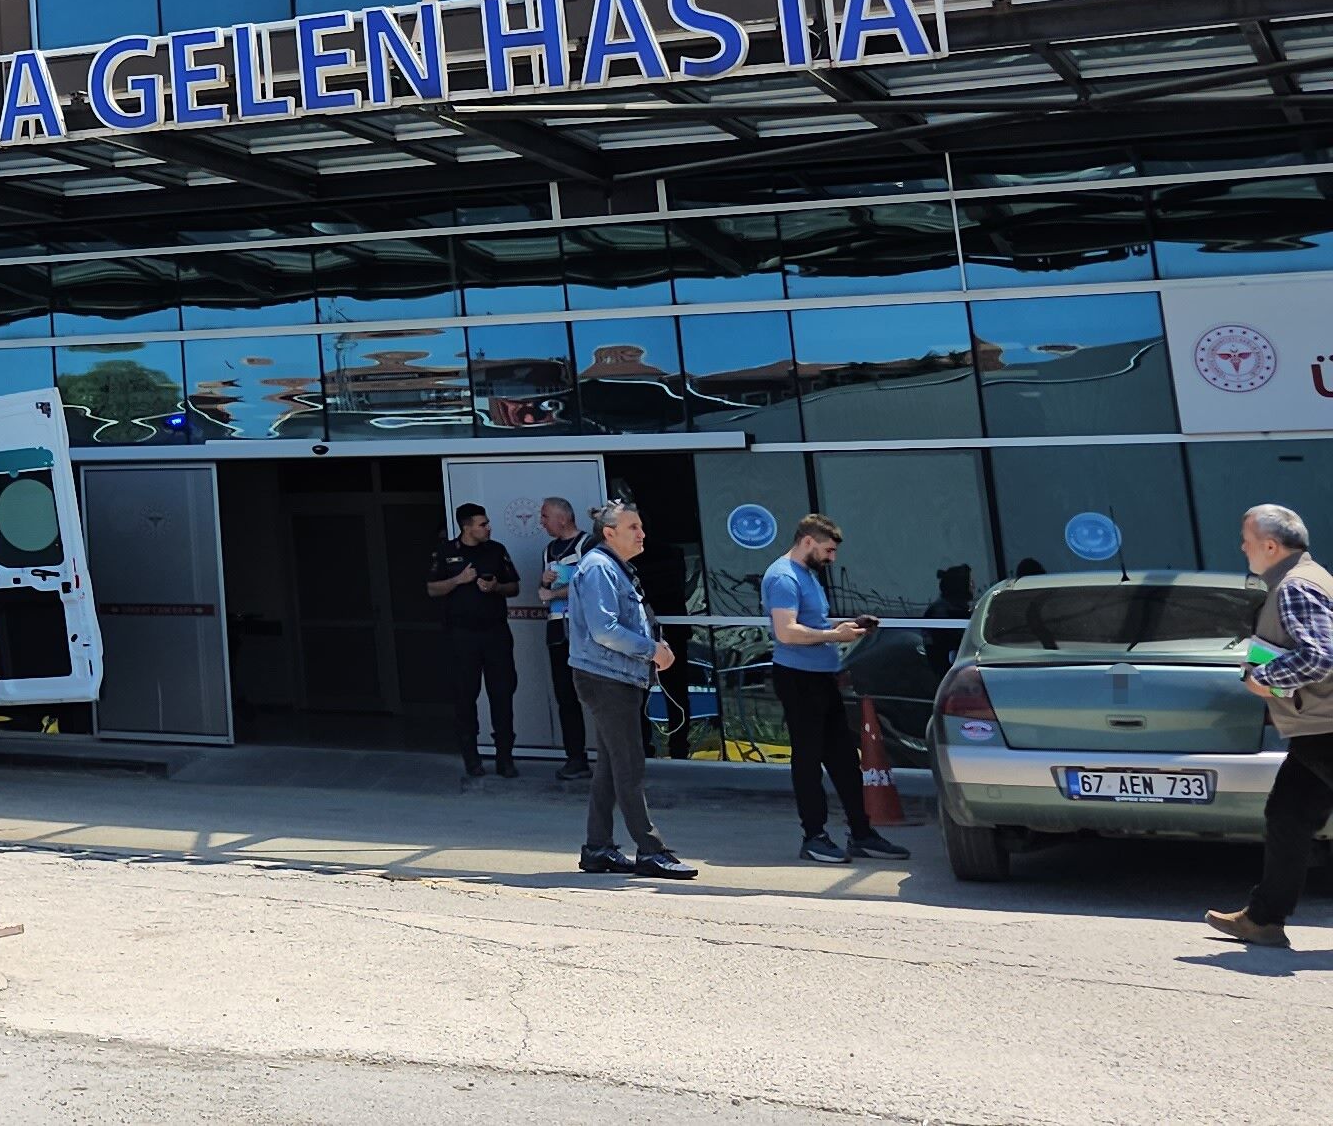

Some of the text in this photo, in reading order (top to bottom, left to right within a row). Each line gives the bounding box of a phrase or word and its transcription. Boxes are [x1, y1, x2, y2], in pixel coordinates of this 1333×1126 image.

[88, 0, 449, 131] GELEN
[1081, 774, 1205, 796] 67 AEN 733
